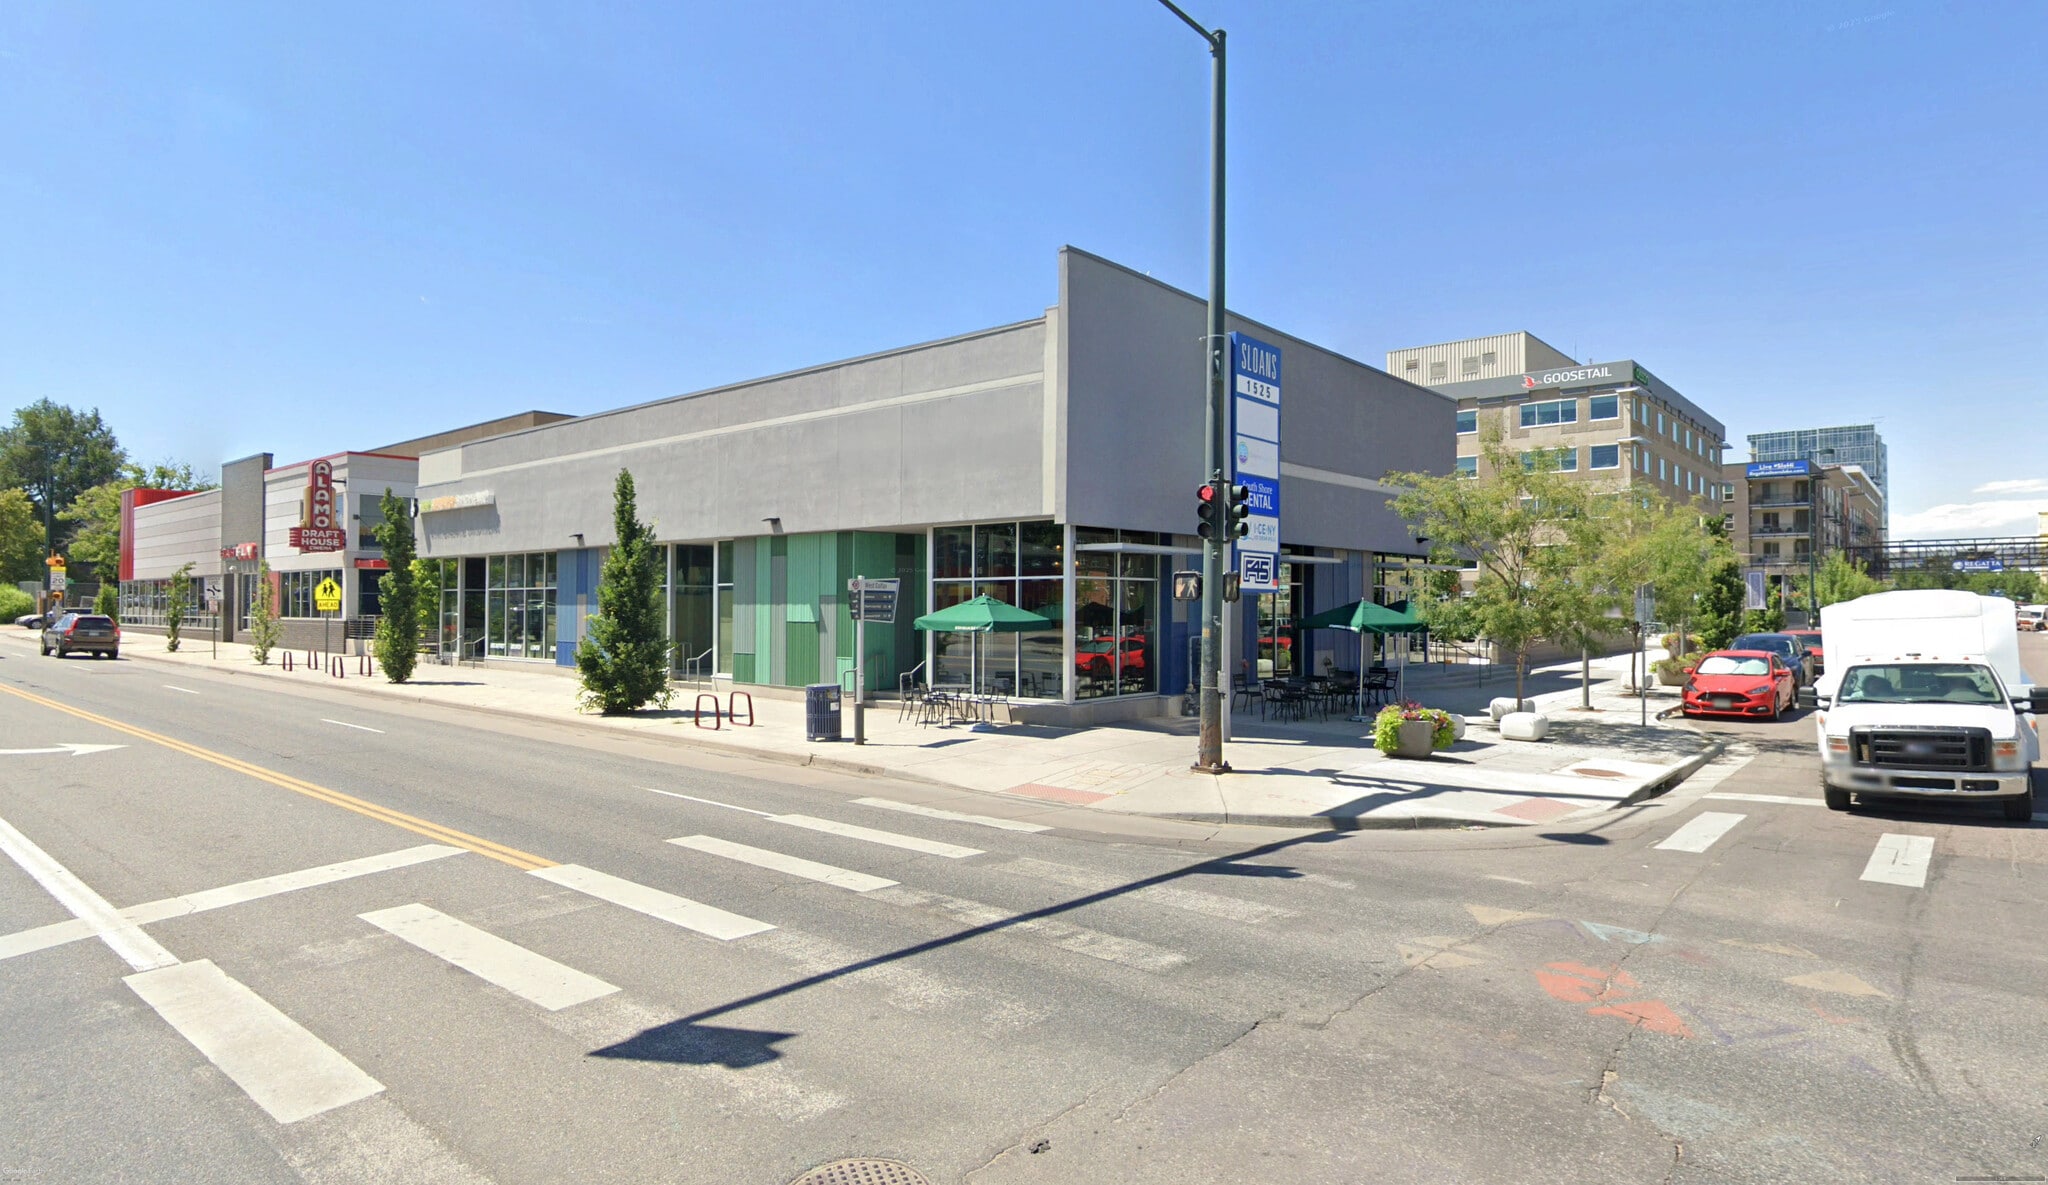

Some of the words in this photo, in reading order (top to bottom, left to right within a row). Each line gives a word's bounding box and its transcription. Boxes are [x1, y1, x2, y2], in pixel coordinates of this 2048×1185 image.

[1241, 342, 1277, 380] SLOANS
[1543, 366, 1612, 384] GOOSETAIL
[1247, 380, 1271, 399] 1525
[315, 463, 330, 527] ALAMO
[1258, 483, 1273, 494] Shore
[301, 529, 340, 538] DRAFT
[301, 538, 340, 547] HOUSE
[1244, 557, 1271, 582] F45
